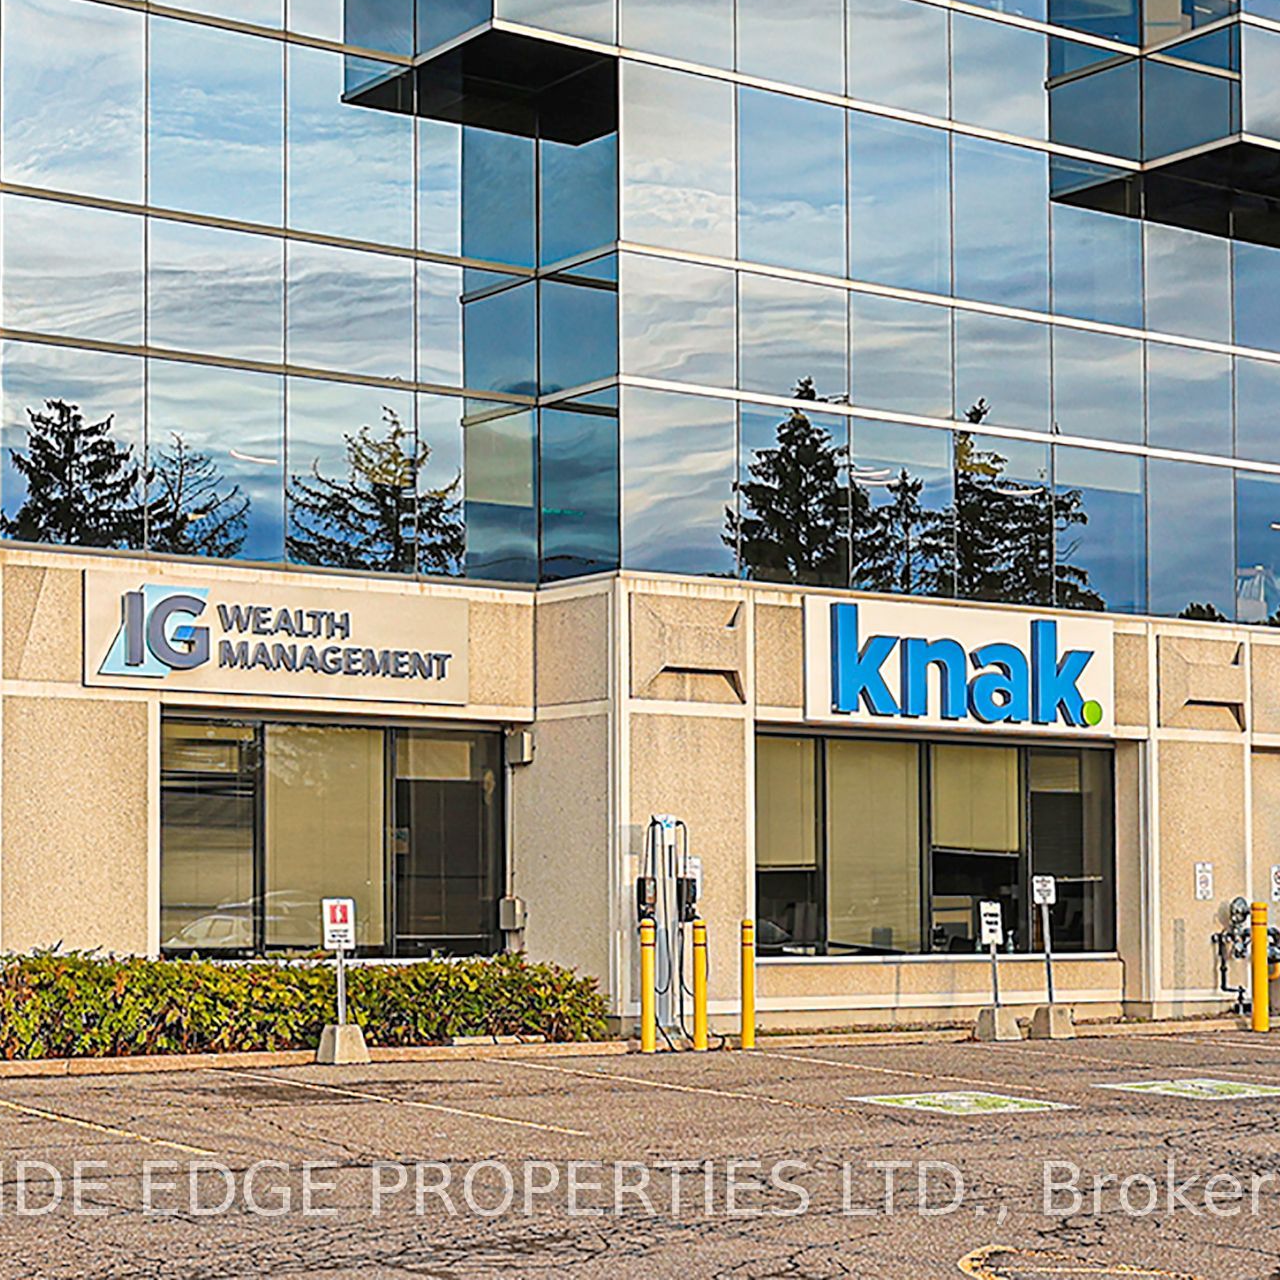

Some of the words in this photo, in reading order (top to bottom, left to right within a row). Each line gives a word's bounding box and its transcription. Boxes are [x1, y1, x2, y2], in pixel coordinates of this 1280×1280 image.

[122, 591, 210, 671] IG
[217, 604, 351, 640] WEALTH
[218, 639, 453, 681] MANAGEMENT
